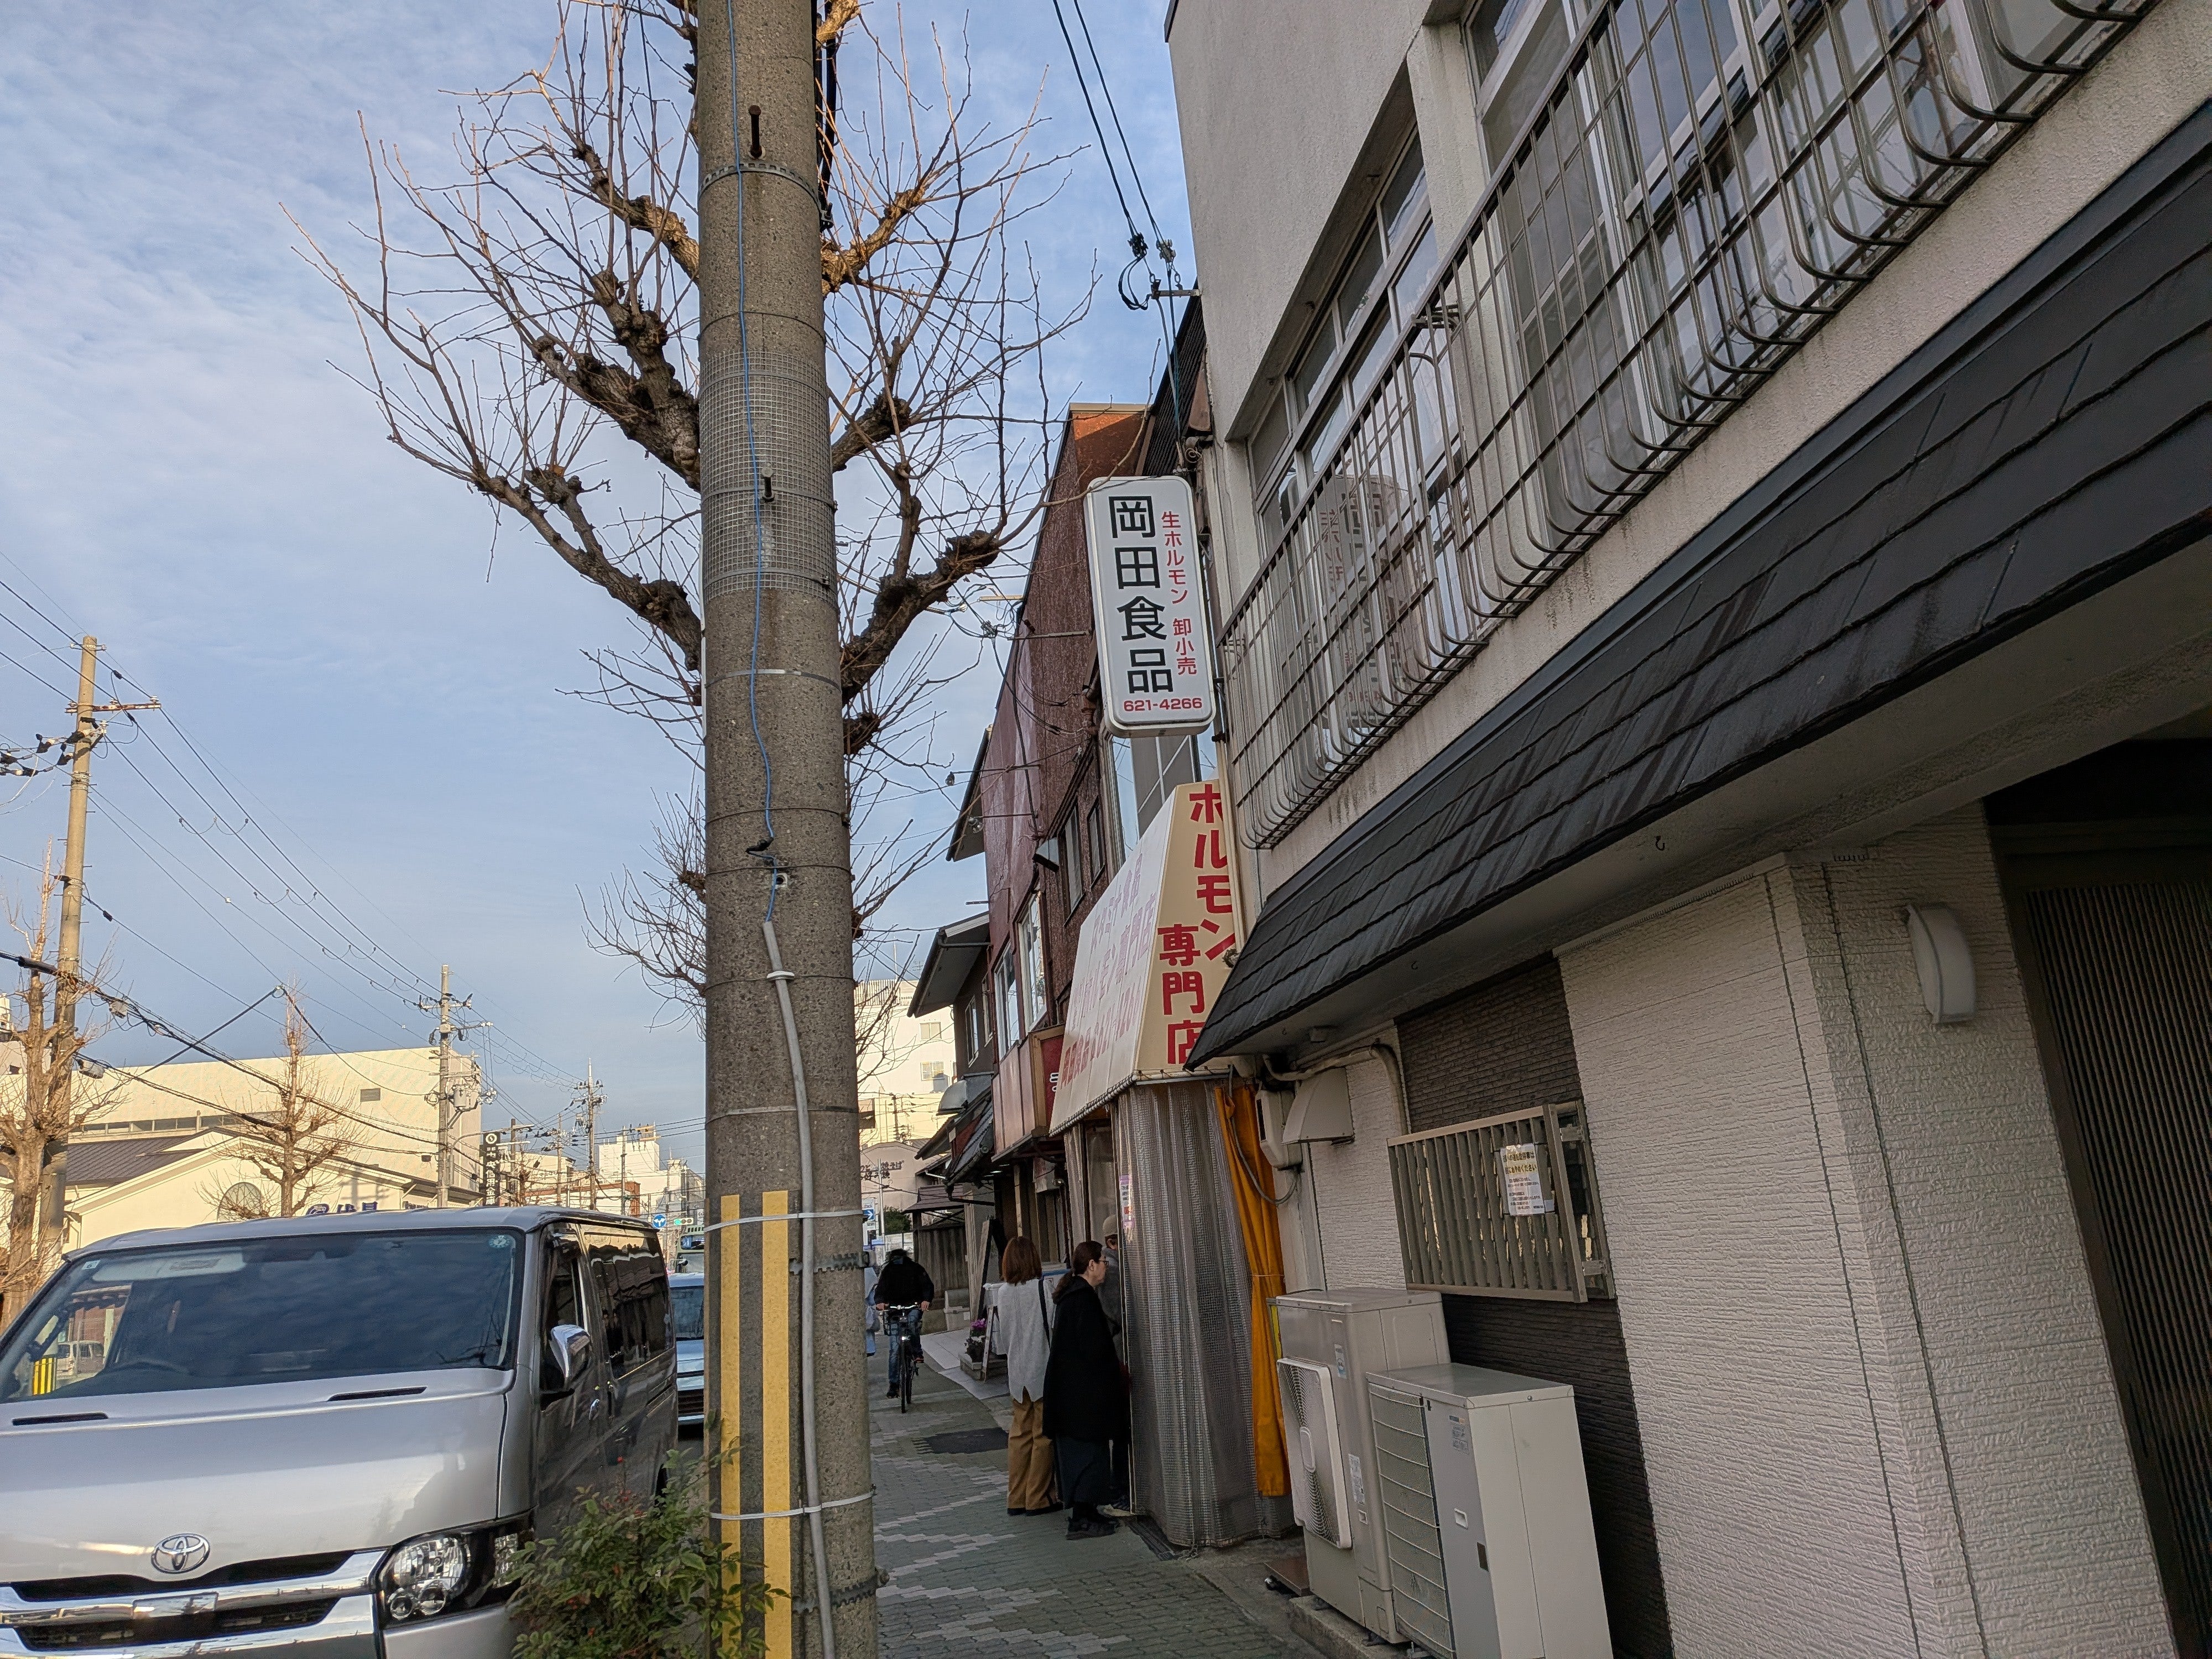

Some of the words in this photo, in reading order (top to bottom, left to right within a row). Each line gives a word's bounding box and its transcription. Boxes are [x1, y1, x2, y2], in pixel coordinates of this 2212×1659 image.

[1108, 495, 1173, 694] 岡田食品
[1161, 511, 1188, 604] 生ホルモン
[1173, 618, 1197, 676] 卸小売
[1124, 697, 1203, 712] 621-4266
[1189, 784, 1235, 961] ホルモン
[1157, 924, 1206, 1065] 専門店
[1060, 1026, 1091, 1090] 岡田食品
